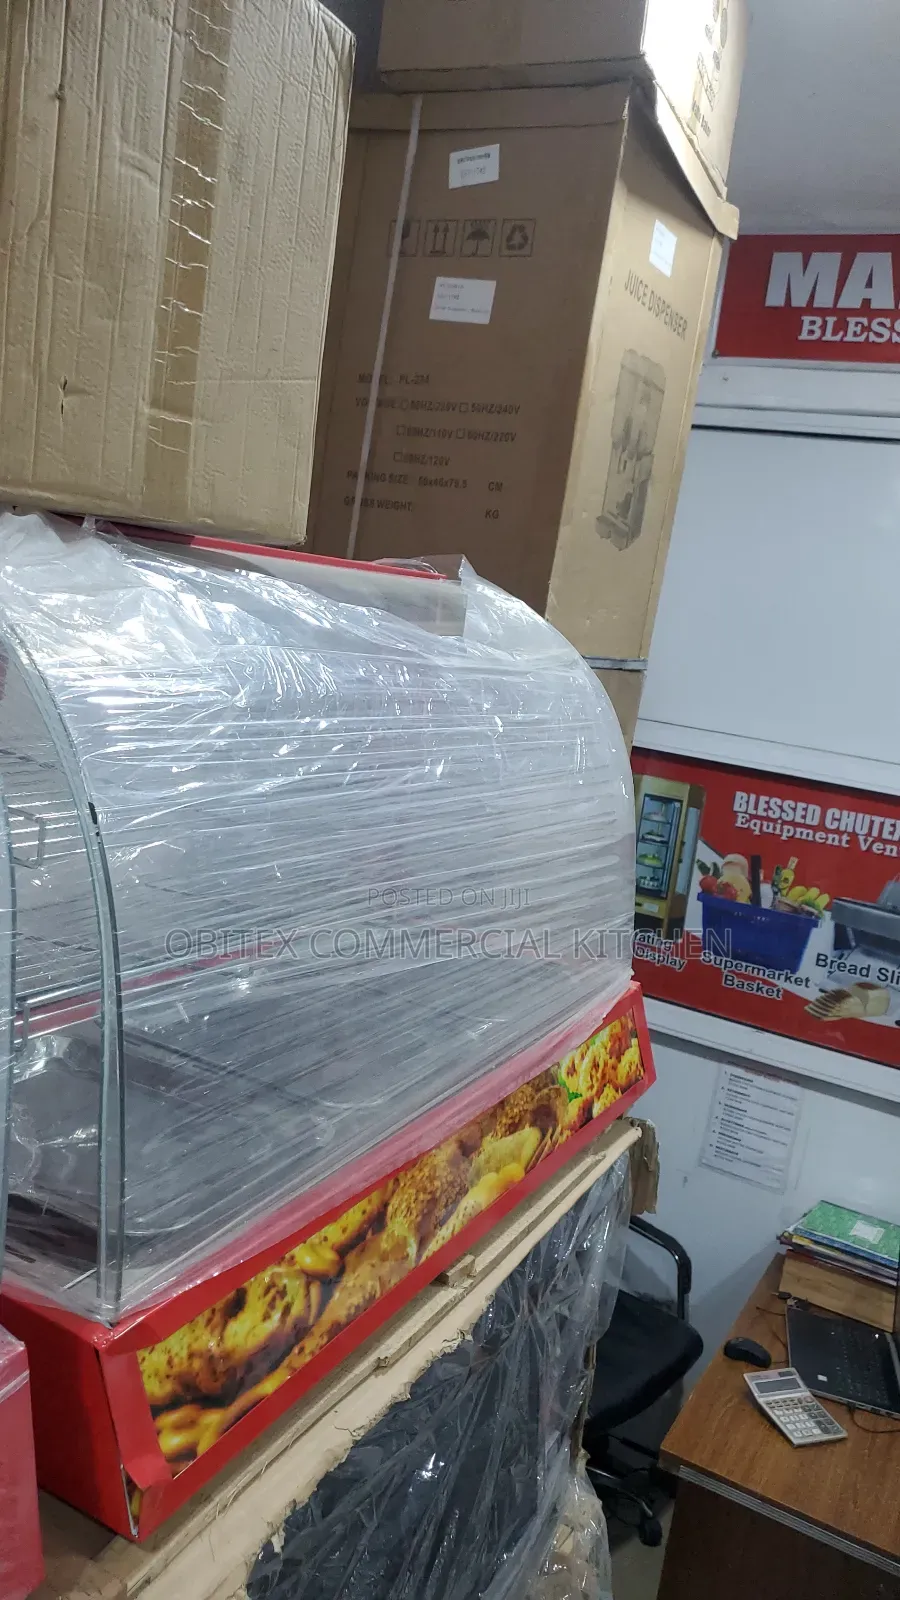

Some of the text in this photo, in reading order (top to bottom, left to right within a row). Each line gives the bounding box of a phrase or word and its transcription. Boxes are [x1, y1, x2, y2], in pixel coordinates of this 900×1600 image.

[765, 252, 900, 309] MA
[624, 268, 688, 340] JUICE DISPENSER
[346, 469, 387, 483] PAKING
[488, 480, 503, 493] CM
[485, 509, 500, 519] KG
[733, 791, 822, 826] BLESSED
[735, 813, 900, 858] Equipment Ven
[634, 932, 674, 952] ating
[635, 946, 687, 971] Display
[701, 951, 811, 989] Supermarket
[815, 952, 871, 978] Bread
[723, 974, 783, 999] Basket
